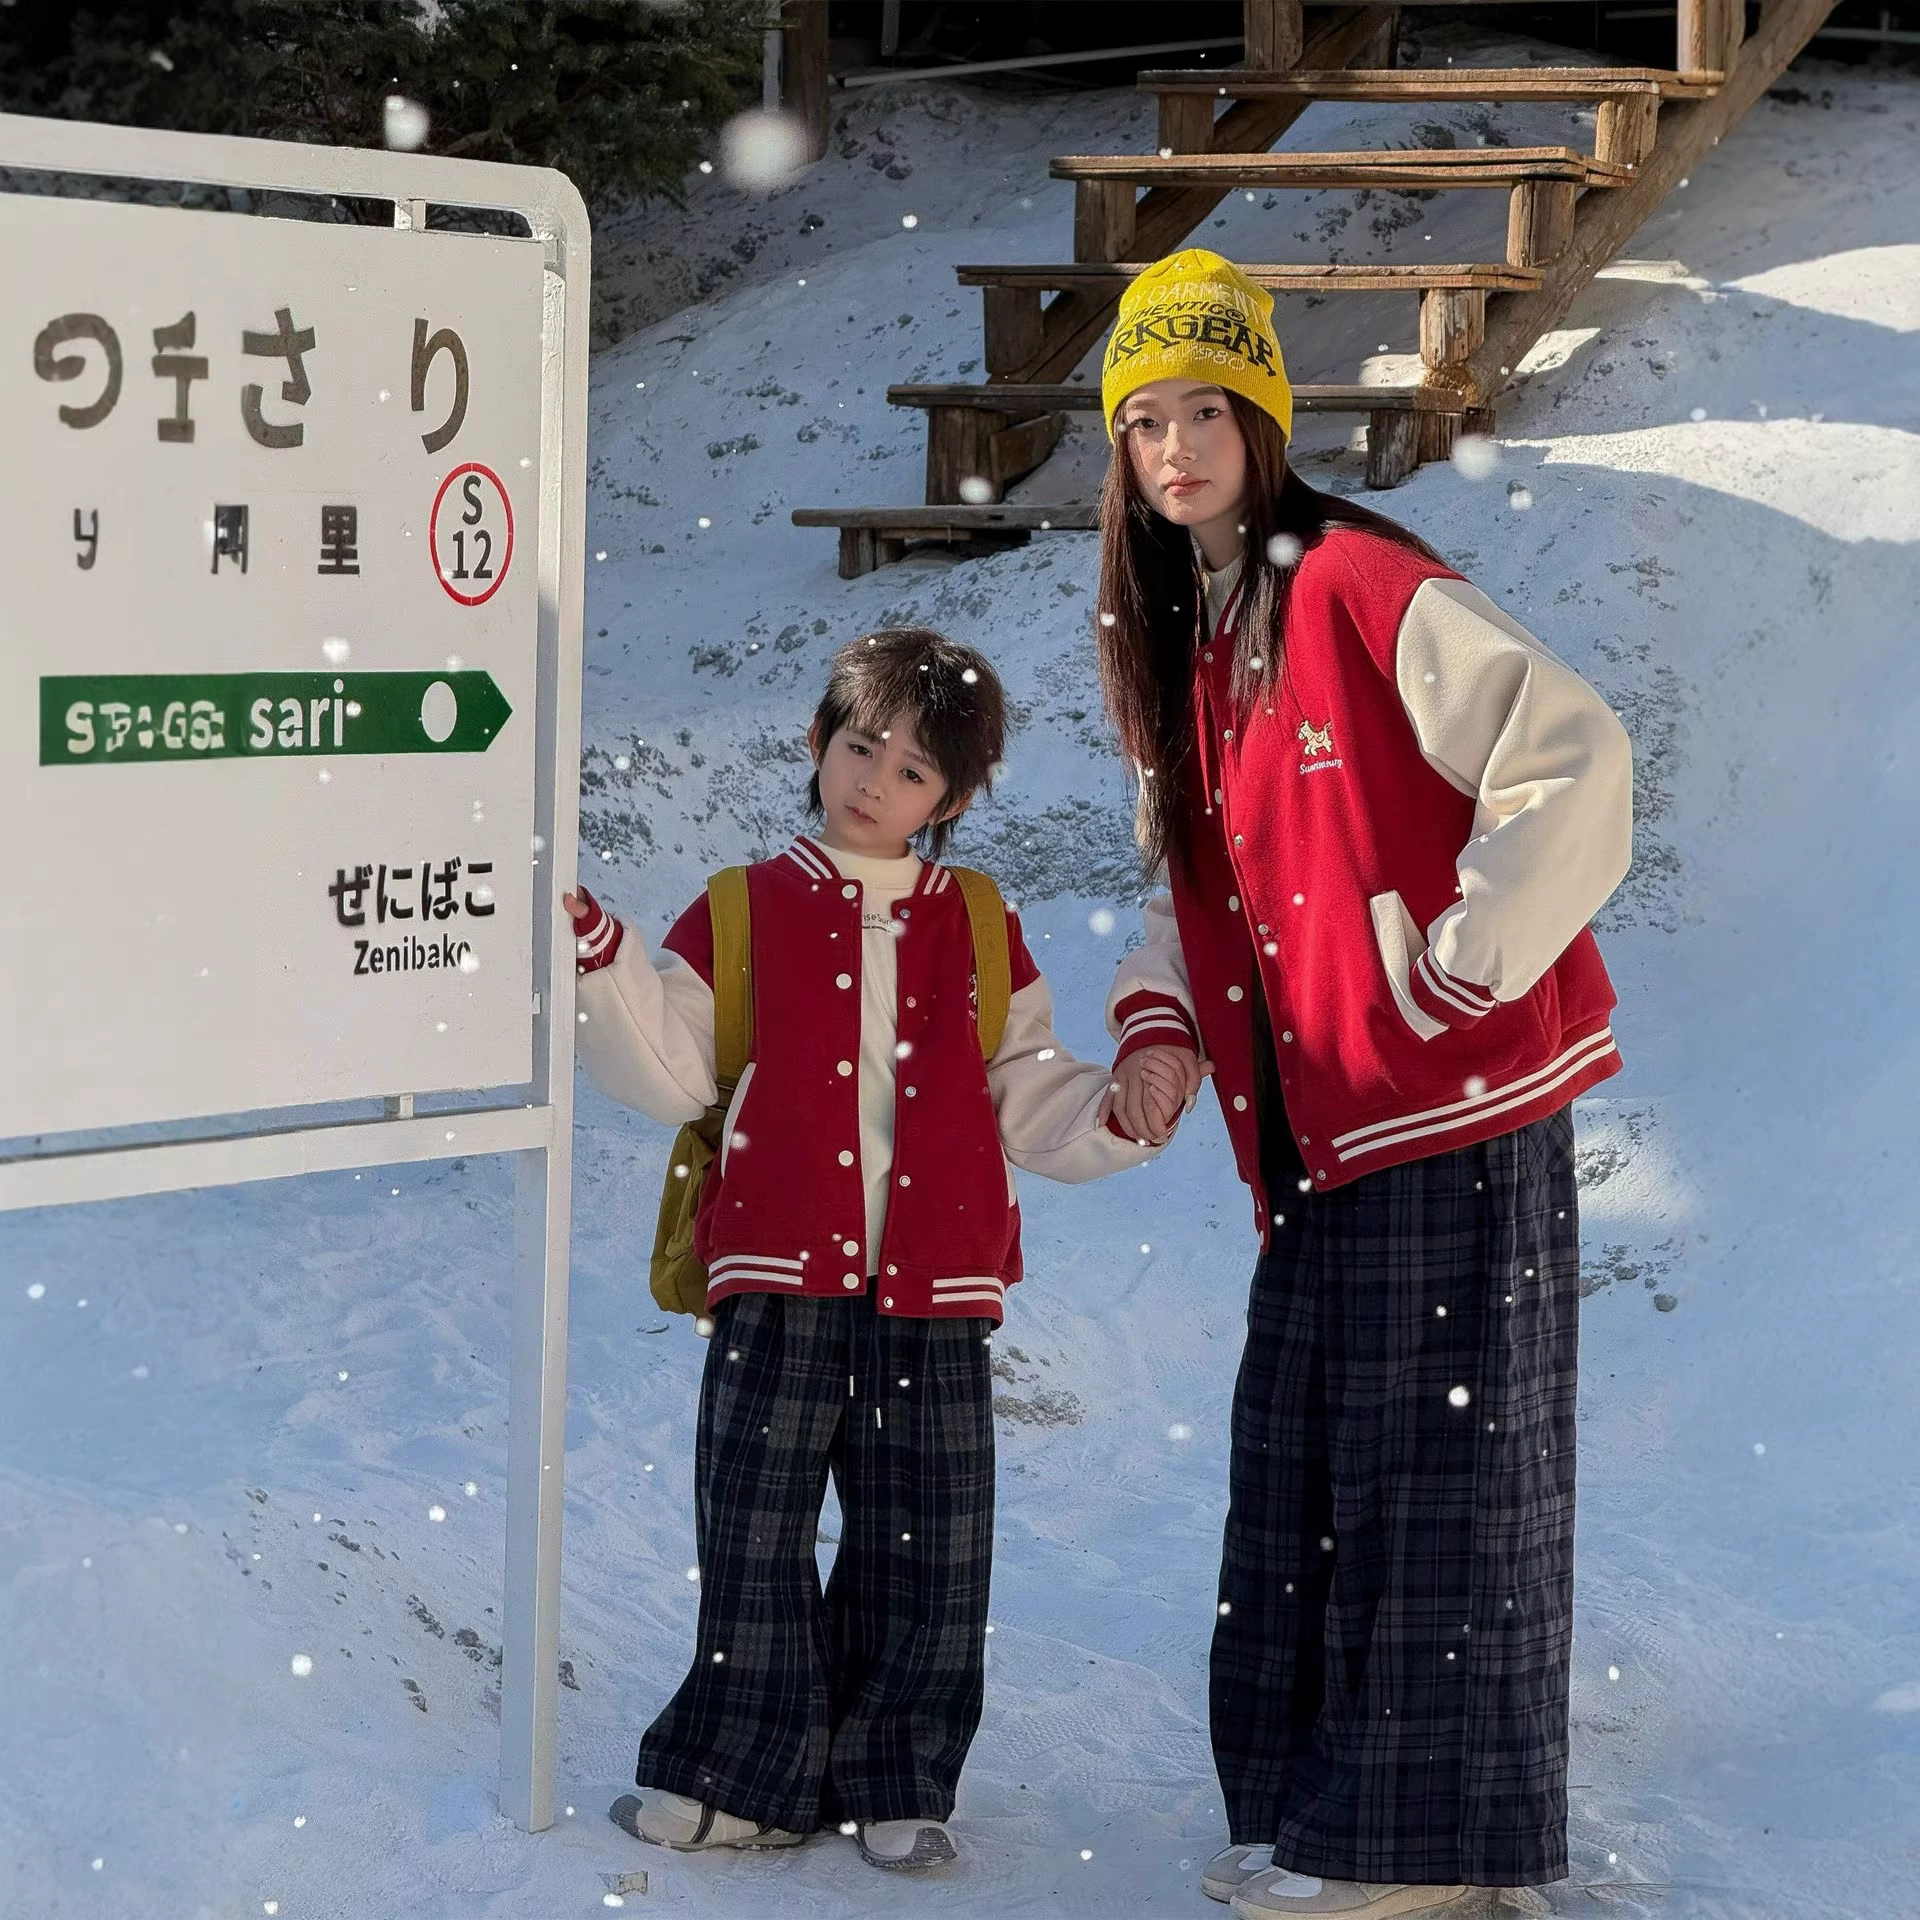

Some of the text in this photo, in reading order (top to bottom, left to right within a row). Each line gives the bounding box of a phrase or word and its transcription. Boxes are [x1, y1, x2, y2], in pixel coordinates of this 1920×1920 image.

[1104, 314, 1277, 377] RKGEAR
[462, 475, 482, 526] S
[452, 530, 493, 580] 12
[250, 679, 344, 748] sari
[328, 856, 495, 926] ぜにばこ
